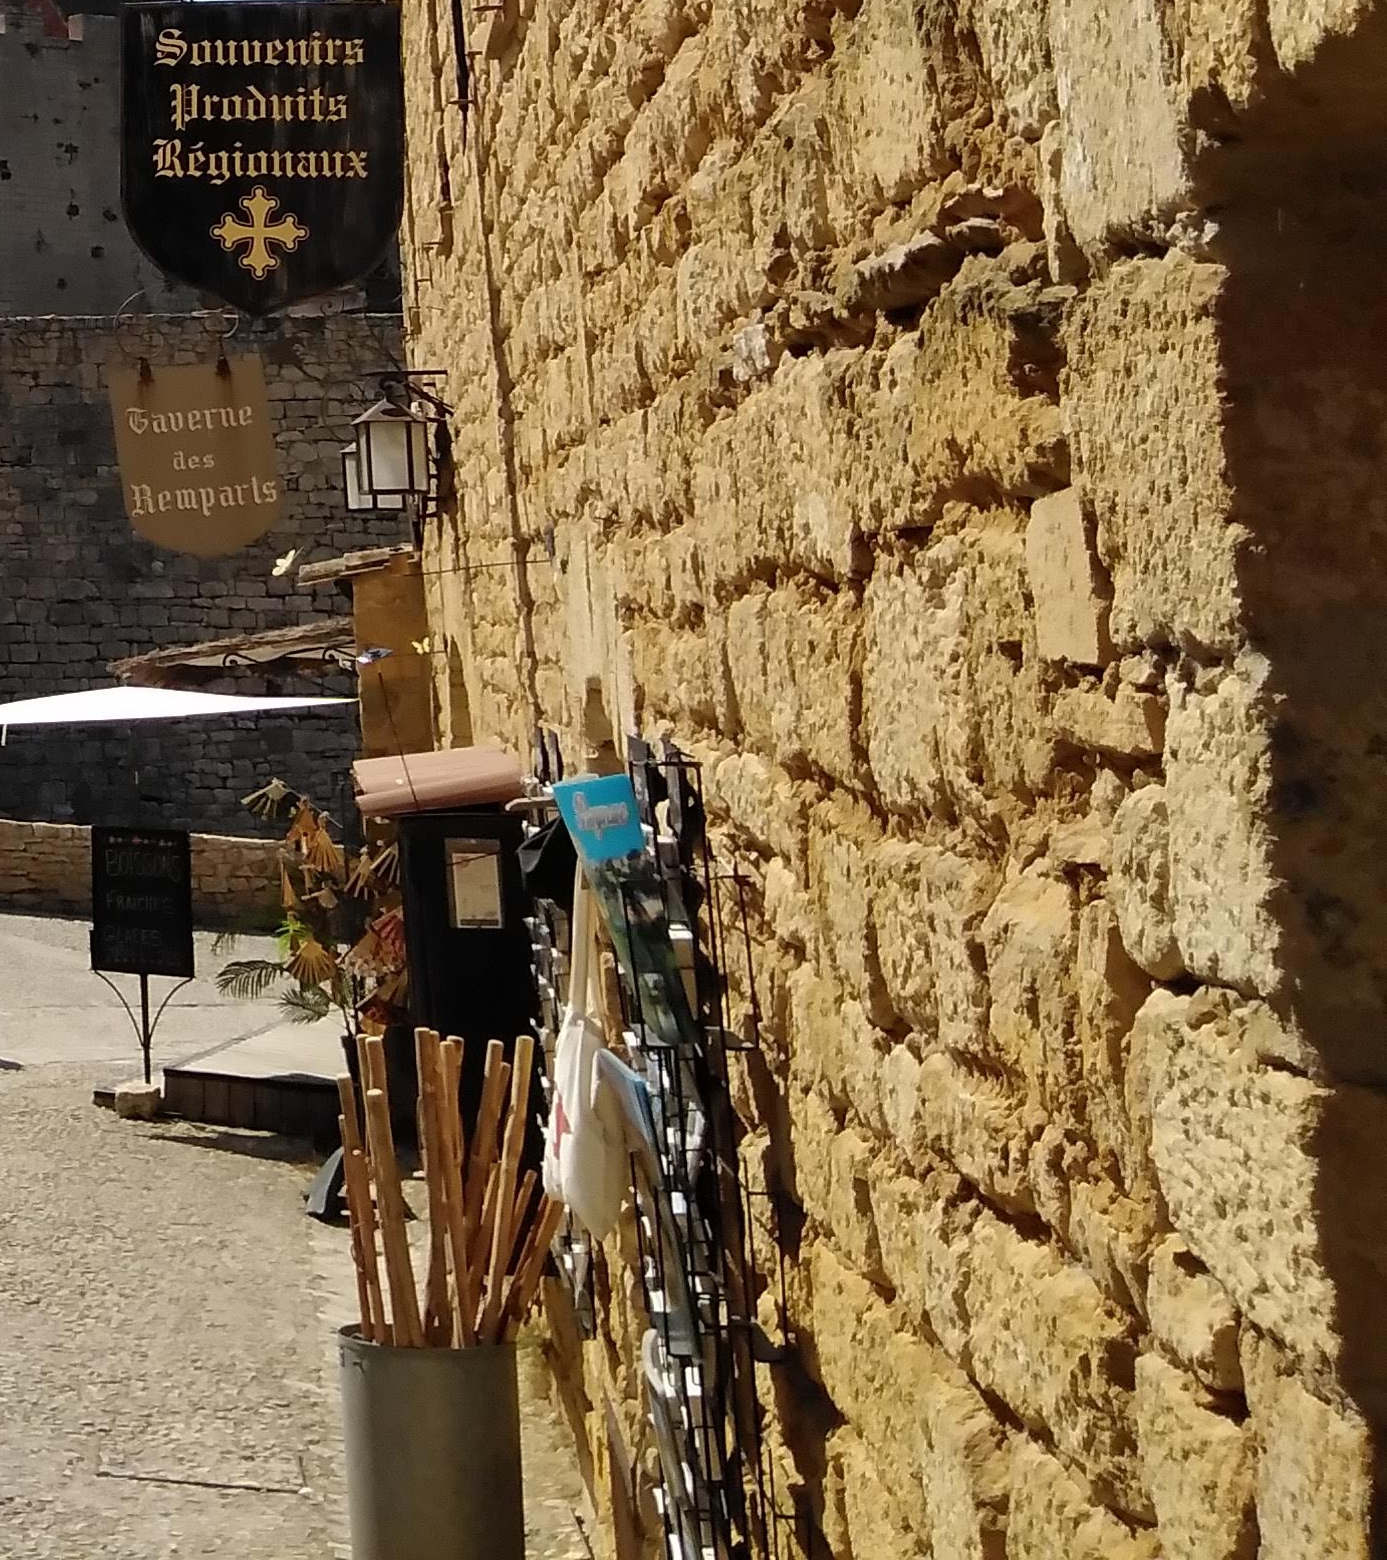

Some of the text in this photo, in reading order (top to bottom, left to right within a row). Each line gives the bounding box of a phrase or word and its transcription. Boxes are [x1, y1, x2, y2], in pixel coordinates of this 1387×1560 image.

[153, 28, 365, 67] Souvenirs
[170, 83, 348, 132] Produits
[152, 138, 369, 185] Régionaux
[127, 406, 254, 435] Taverne
[173, 450, 216, 471] des
[131, 476, 278, 517] Remparts
